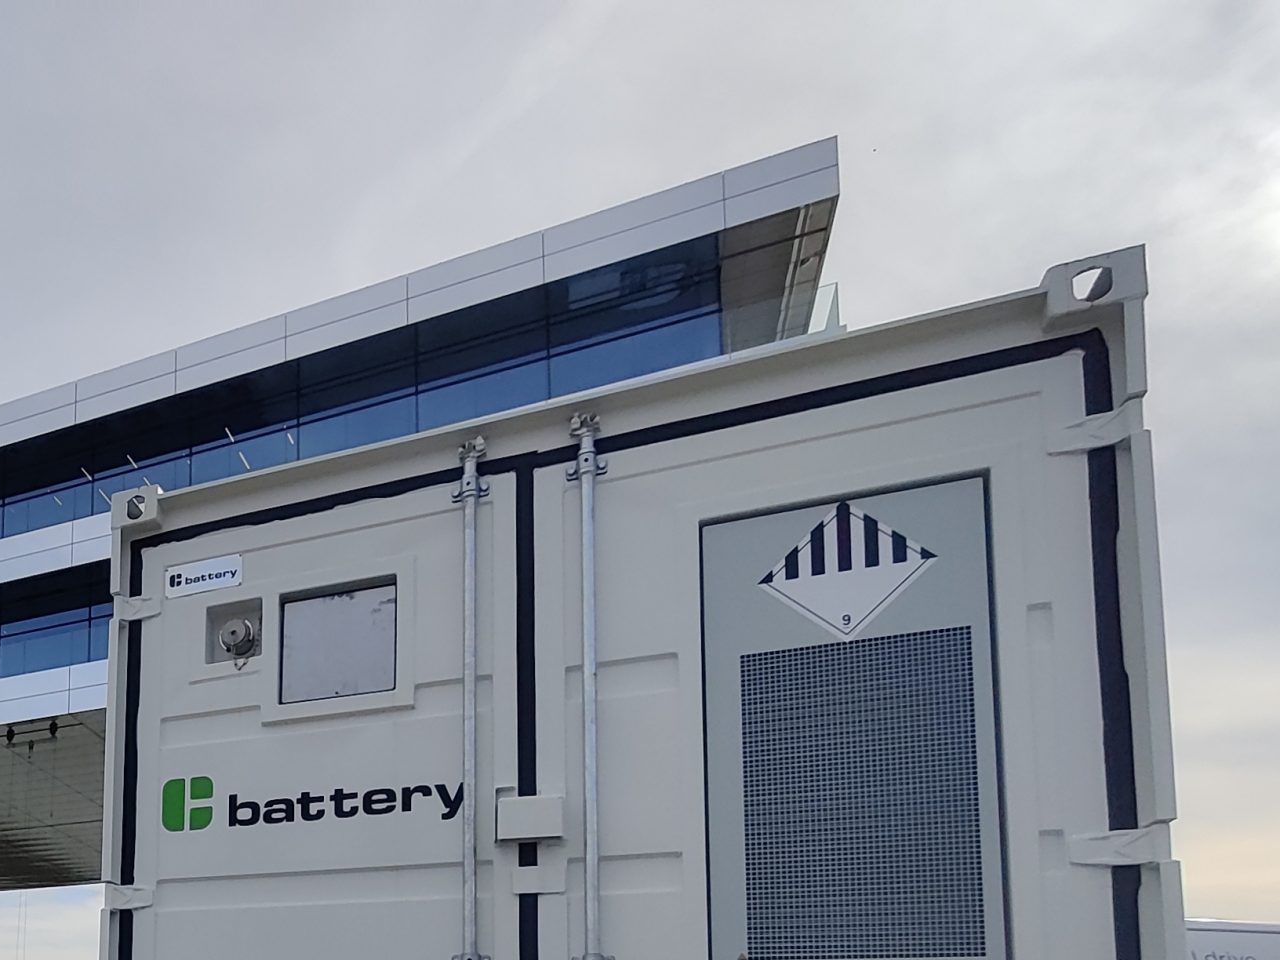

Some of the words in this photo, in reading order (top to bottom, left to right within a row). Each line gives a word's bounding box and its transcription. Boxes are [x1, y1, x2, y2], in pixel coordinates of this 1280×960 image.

[185, 569, 238, 586] battery
[842, 614, 852, 626] 9
[228, 782, 464, 827] battery
